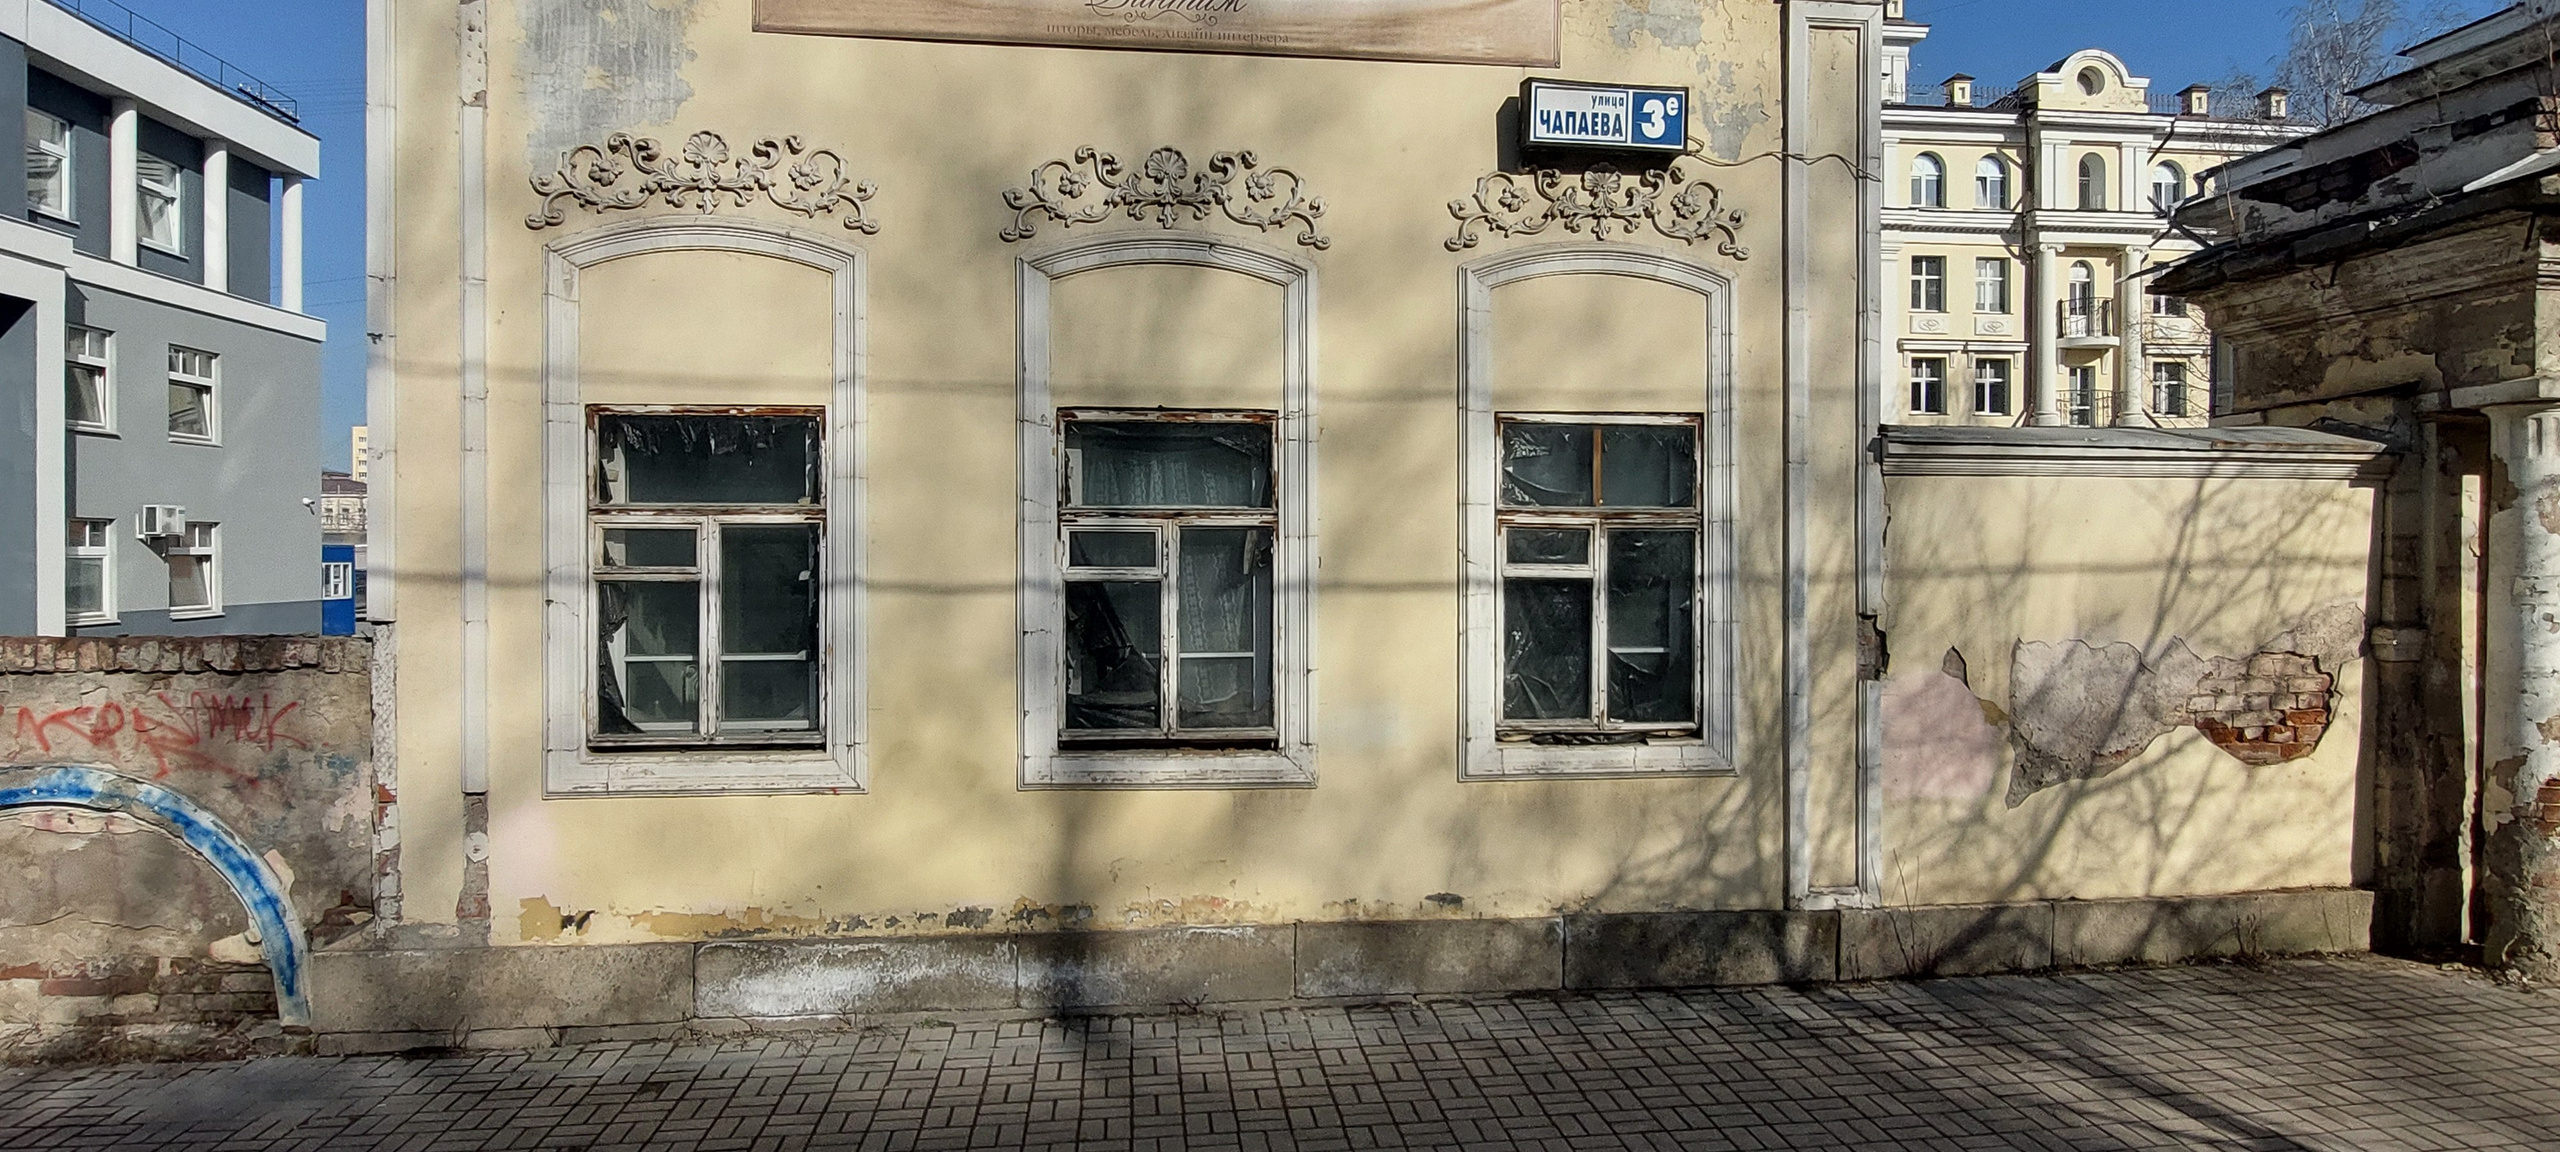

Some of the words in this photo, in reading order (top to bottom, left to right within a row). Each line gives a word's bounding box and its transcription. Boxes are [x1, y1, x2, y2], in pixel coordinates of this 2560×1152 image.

[1046, 24, 1101, 38] шторы,
[1104, 24, 1159, 39] мебель,
[1162, 27, 1213, 40] дизайн
[1217, 31, 1289, 46] интерьера
[1591, 94, 1625, 109] улица
[1539, 109, 1624, 137] ЧАПАЕВА
